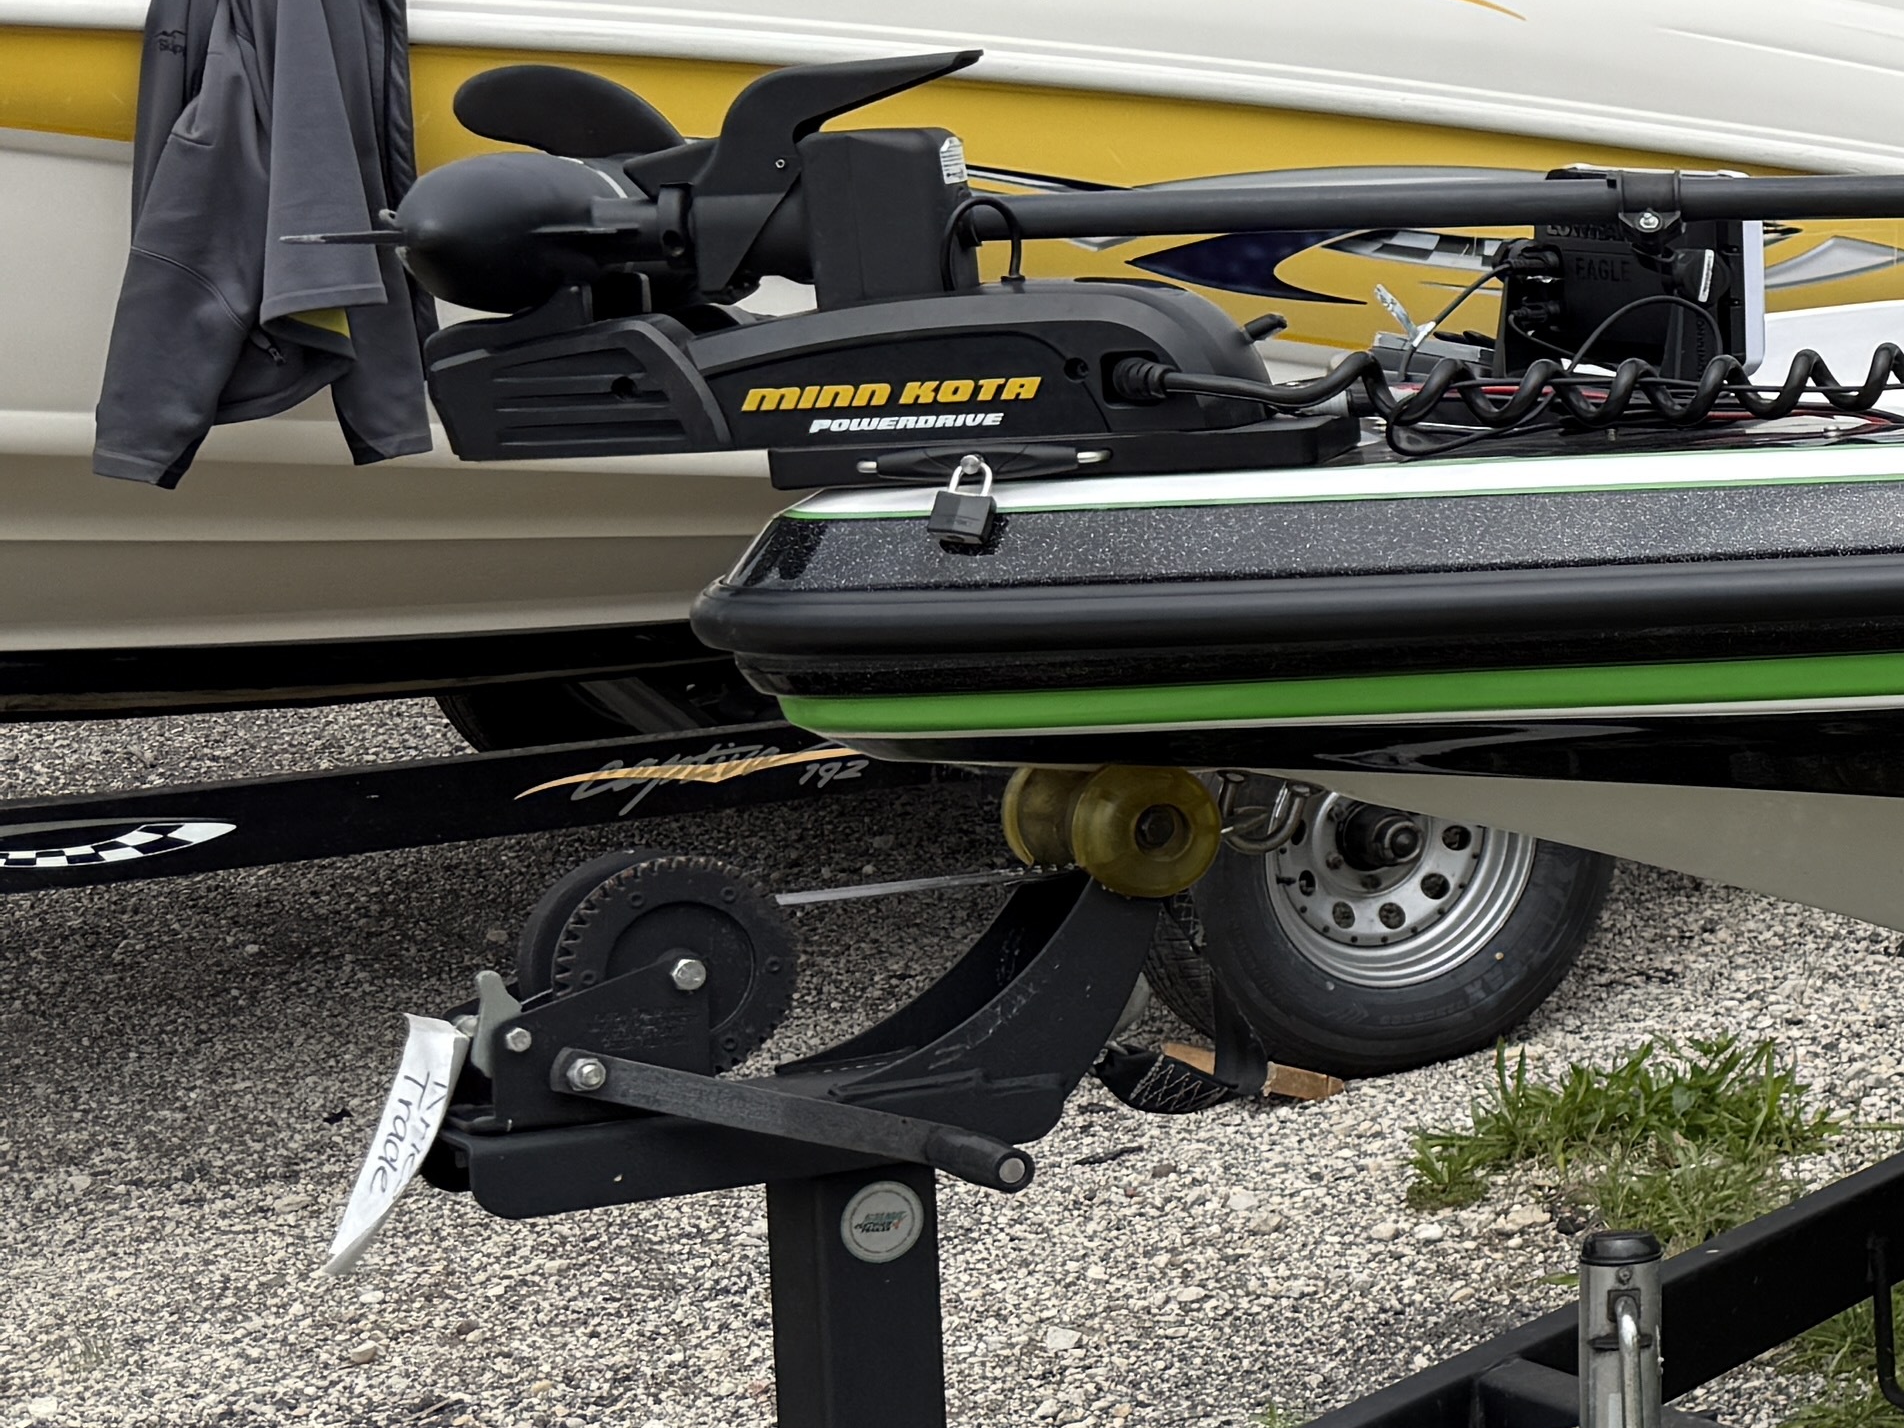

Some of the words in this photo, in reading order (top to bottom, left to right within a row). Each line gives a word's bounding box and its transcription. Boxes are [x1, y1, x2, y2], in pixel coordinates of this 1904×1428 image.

[1575, 257, 1632, 282] EAGLE
[740, 383, 892, 412] MINN
[897, 376, 1042, 405] KOTA
[808, 412, 1004, 434] POWERDRIVE
[799, 759, 869, 788] 192
[370, 1071, 430, 1194] Trade
